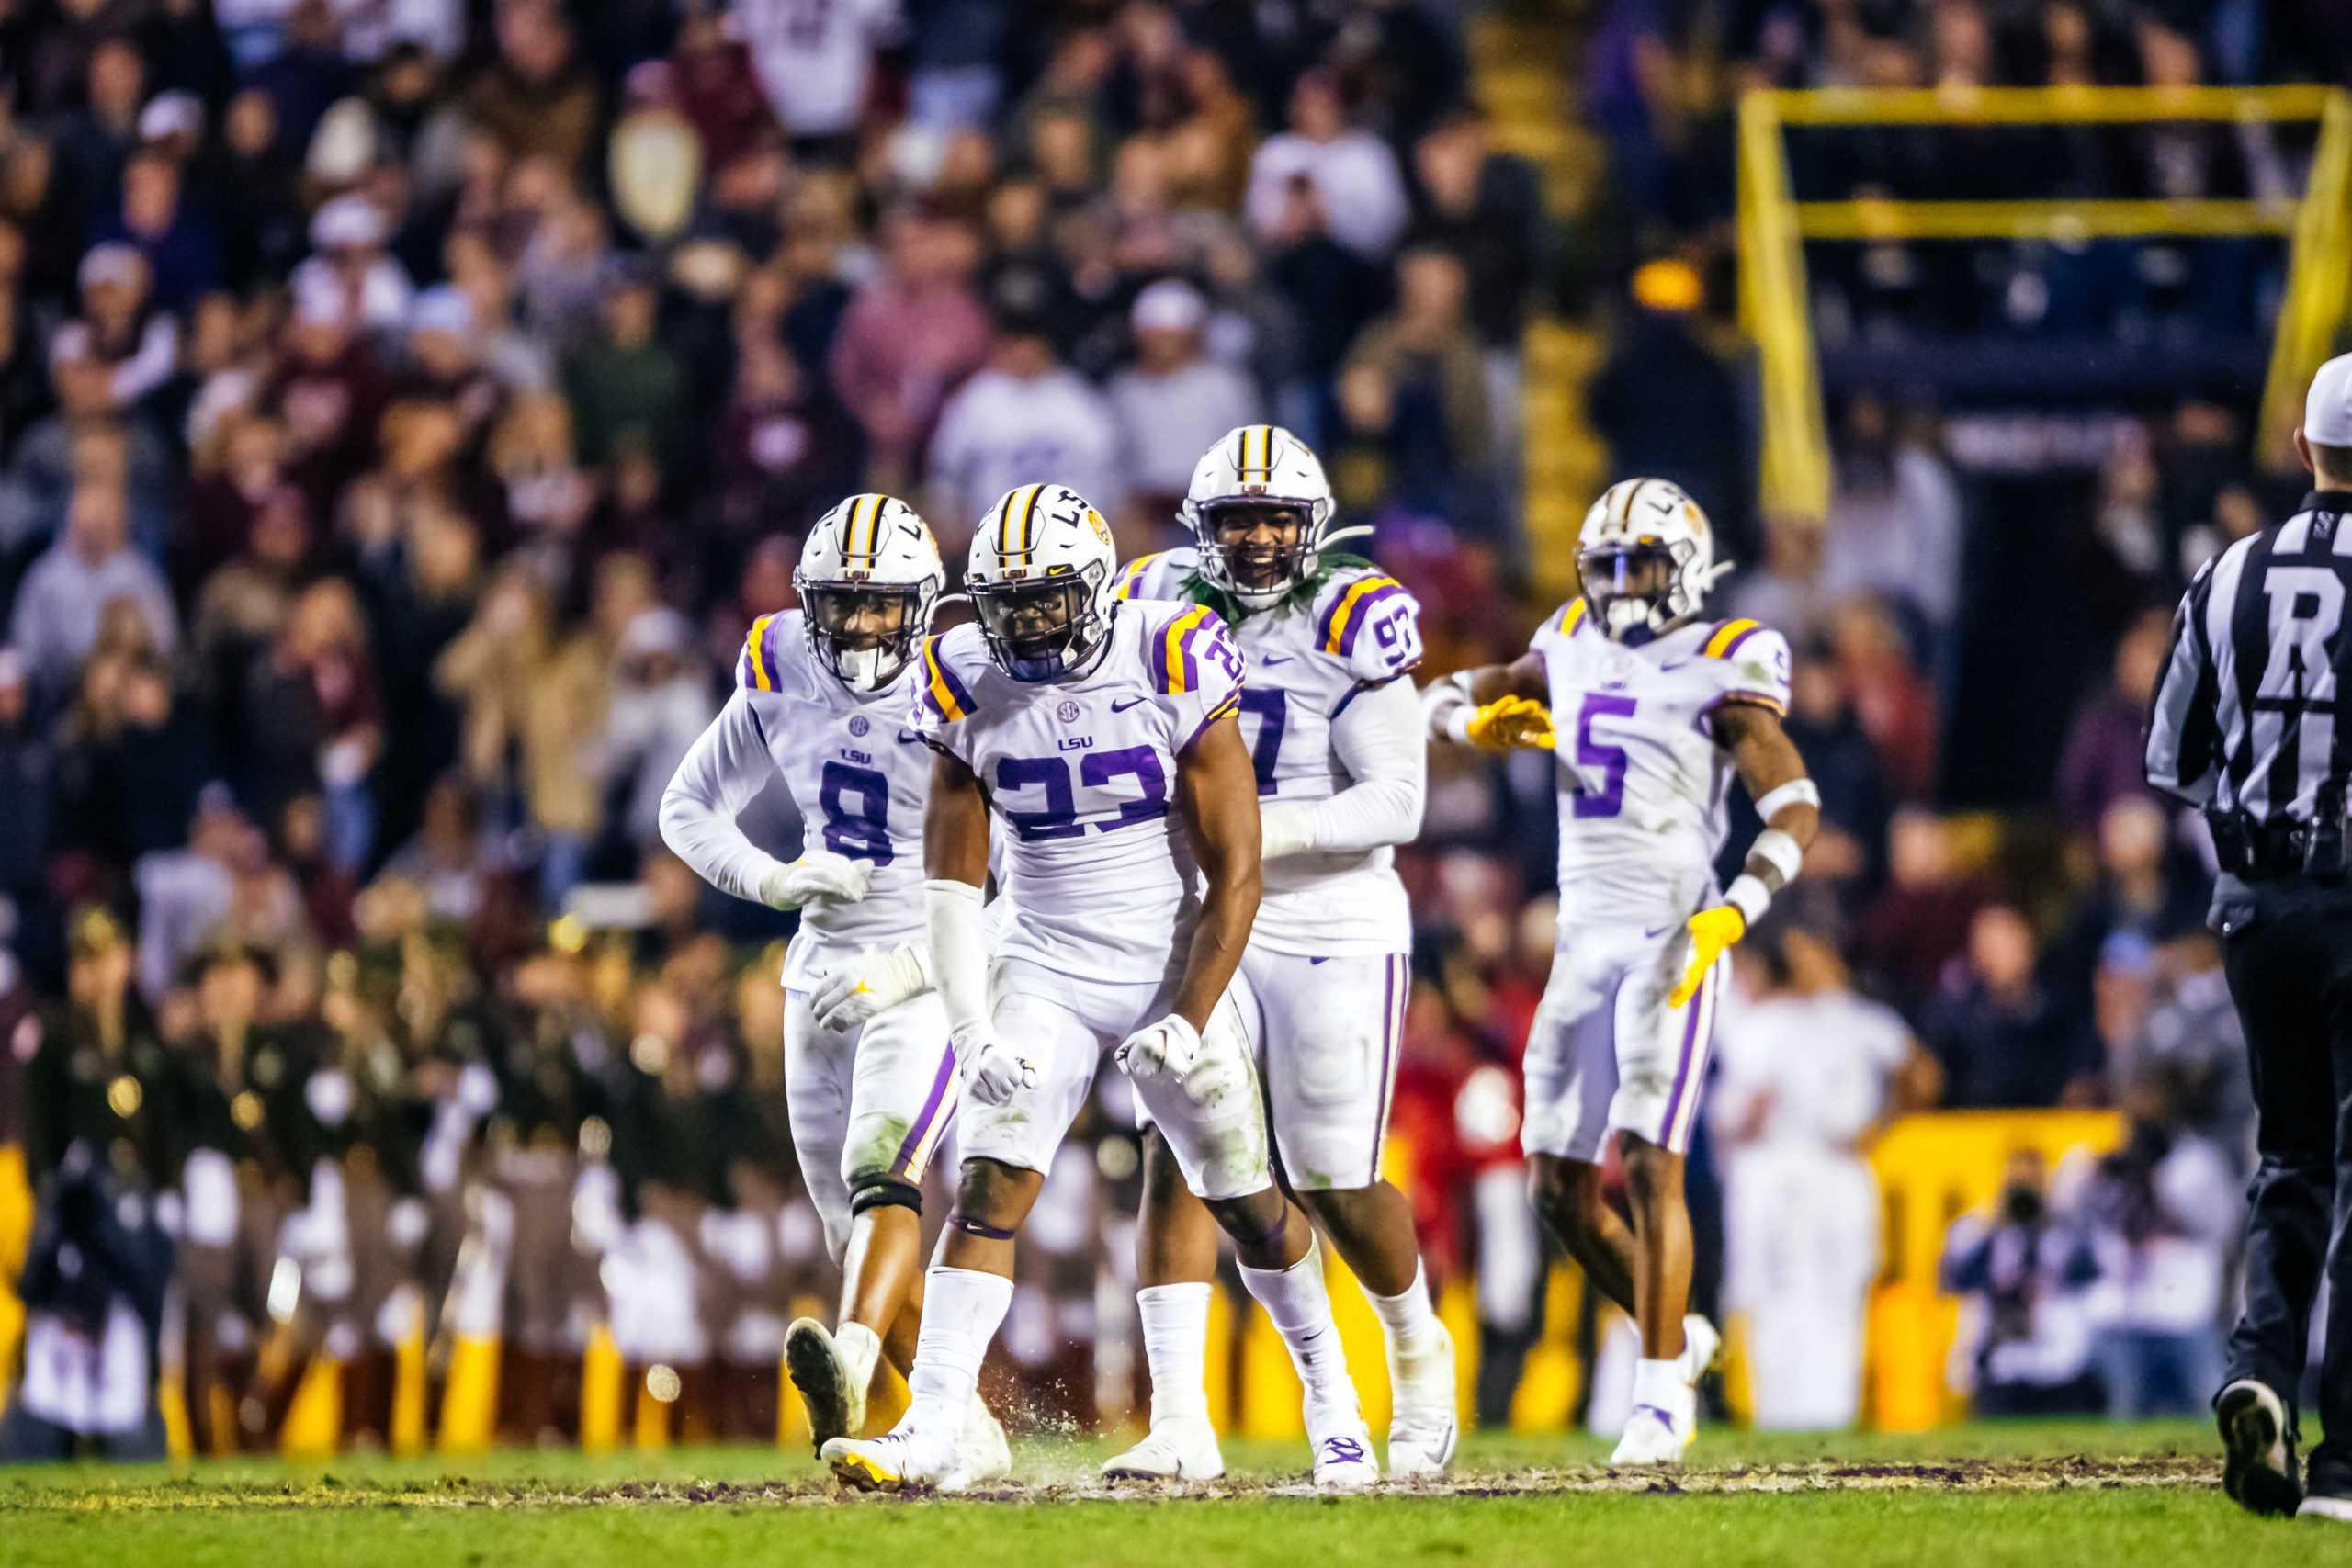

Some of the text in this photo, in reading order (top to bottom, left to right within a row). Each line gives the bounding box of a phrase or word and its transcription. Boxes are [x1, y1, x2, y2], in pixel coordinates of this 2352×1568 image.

[1373, 604, 1412, 667] 97
[2256, 566, 2346, 699] R
[840, 747, 872, 764] LSU
[1058, 736, 1093, 751] LSU
[1240, 688, 1285, 795] 7
[1573, 693, 1637, 818] 5
[819, 760, 895, 867] 8
[996, 744, 1172, 842] 23
